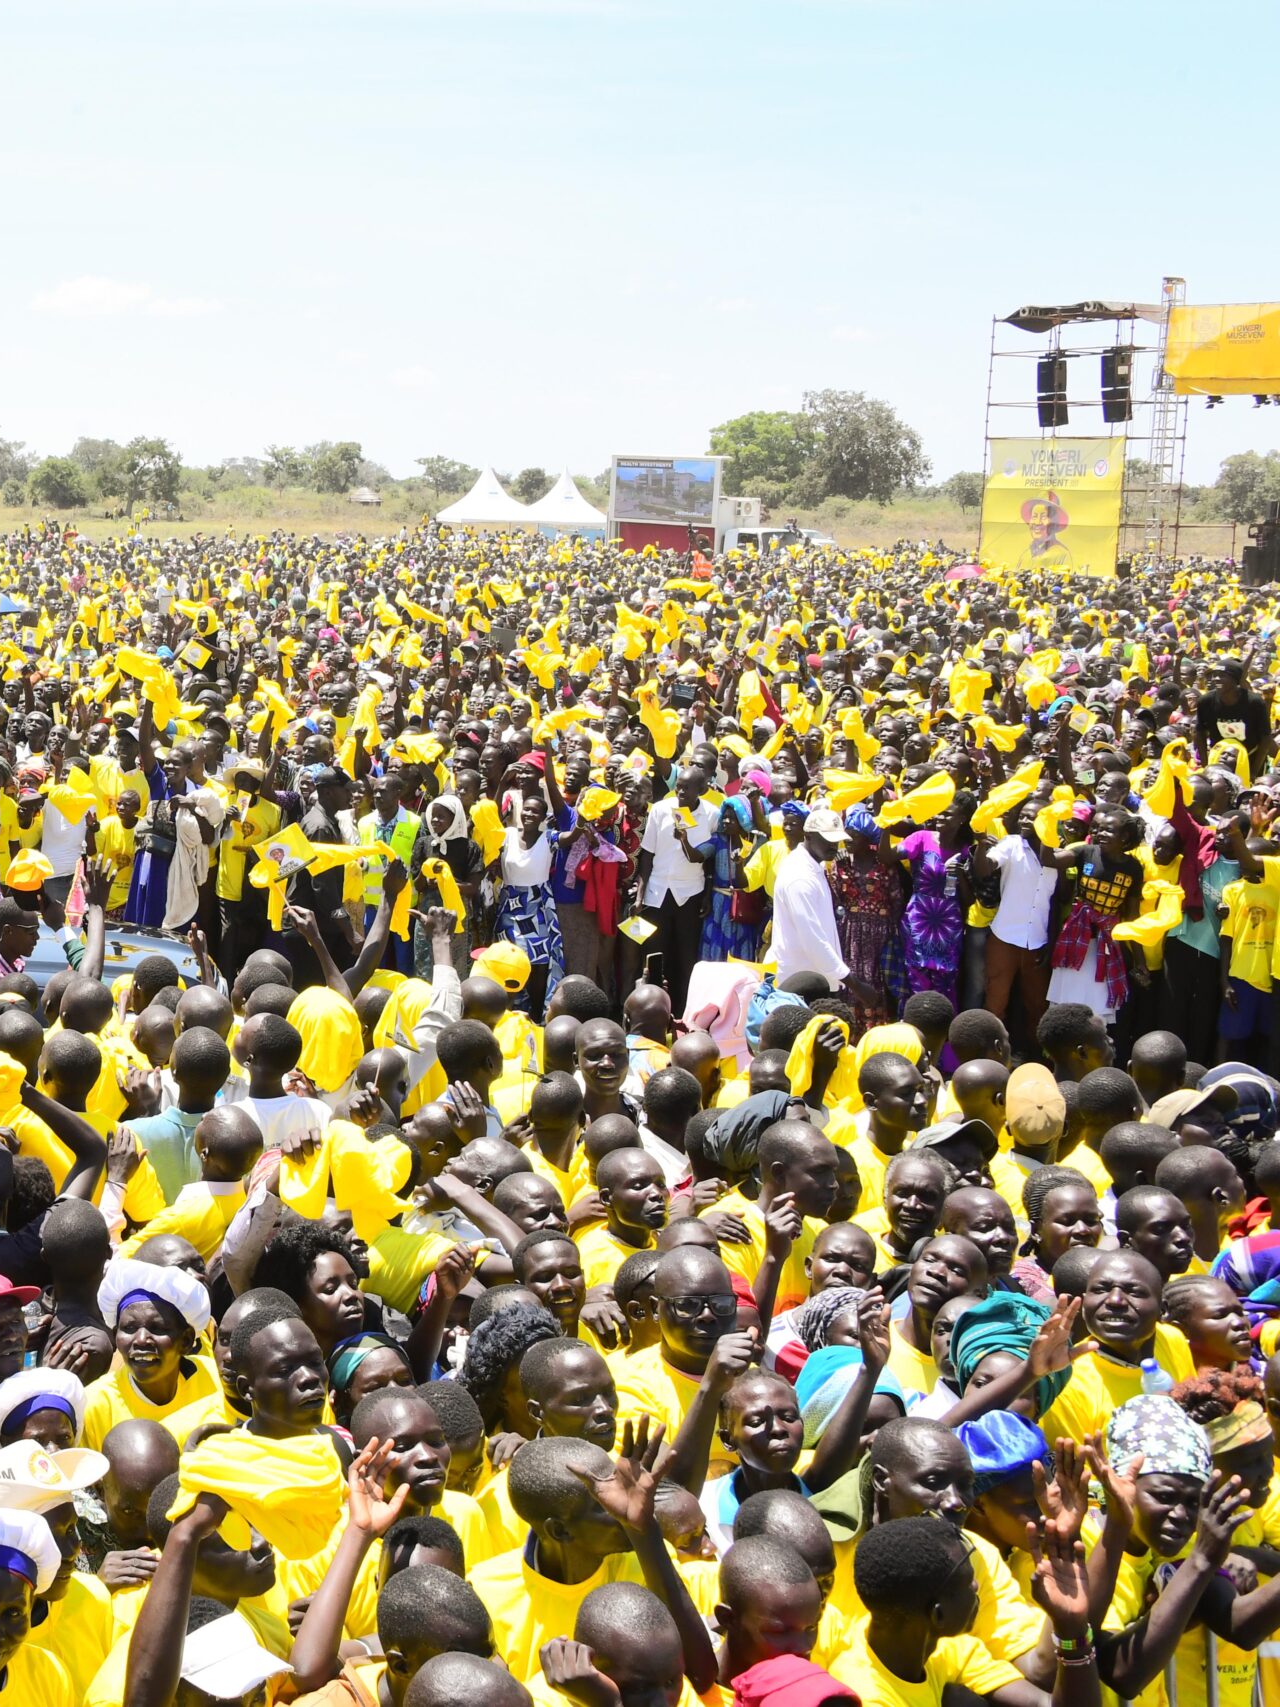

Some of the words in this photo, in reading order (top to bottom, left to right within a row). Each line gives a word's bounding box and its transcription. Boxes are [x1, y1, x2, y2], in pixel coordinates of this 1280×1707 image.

[1231, 323, 1262, 332] YOWERI
[1031, 450, 1081, 463] YOWERI
[1022, 464, 1087, 477] MUSEVENI
[1024, 479, 1068, 487] PRESIDENT
